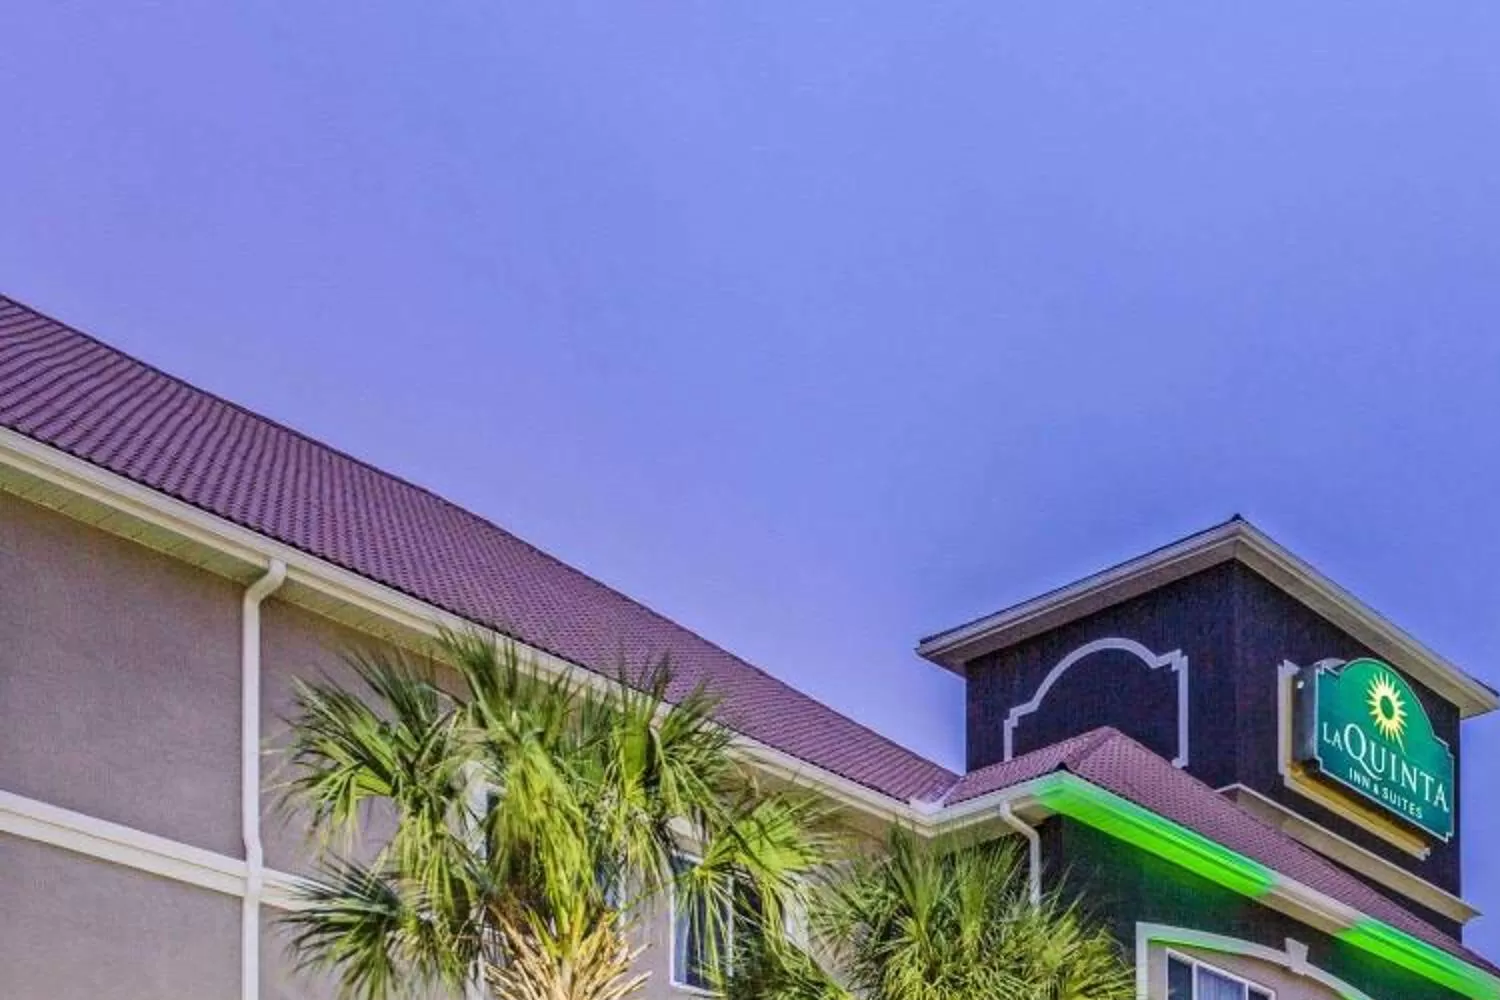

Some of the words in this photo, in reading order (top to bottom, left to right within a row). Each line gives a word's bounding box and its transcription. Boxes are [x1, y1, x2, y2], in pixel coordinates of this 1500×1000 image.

[1323, 722, 1343, 751] LA
[1344, 723, 1449, 812] QUINTA
[1349, 767, 1371, 790] INN
[1382, 787, 1423, 819] SUITES
